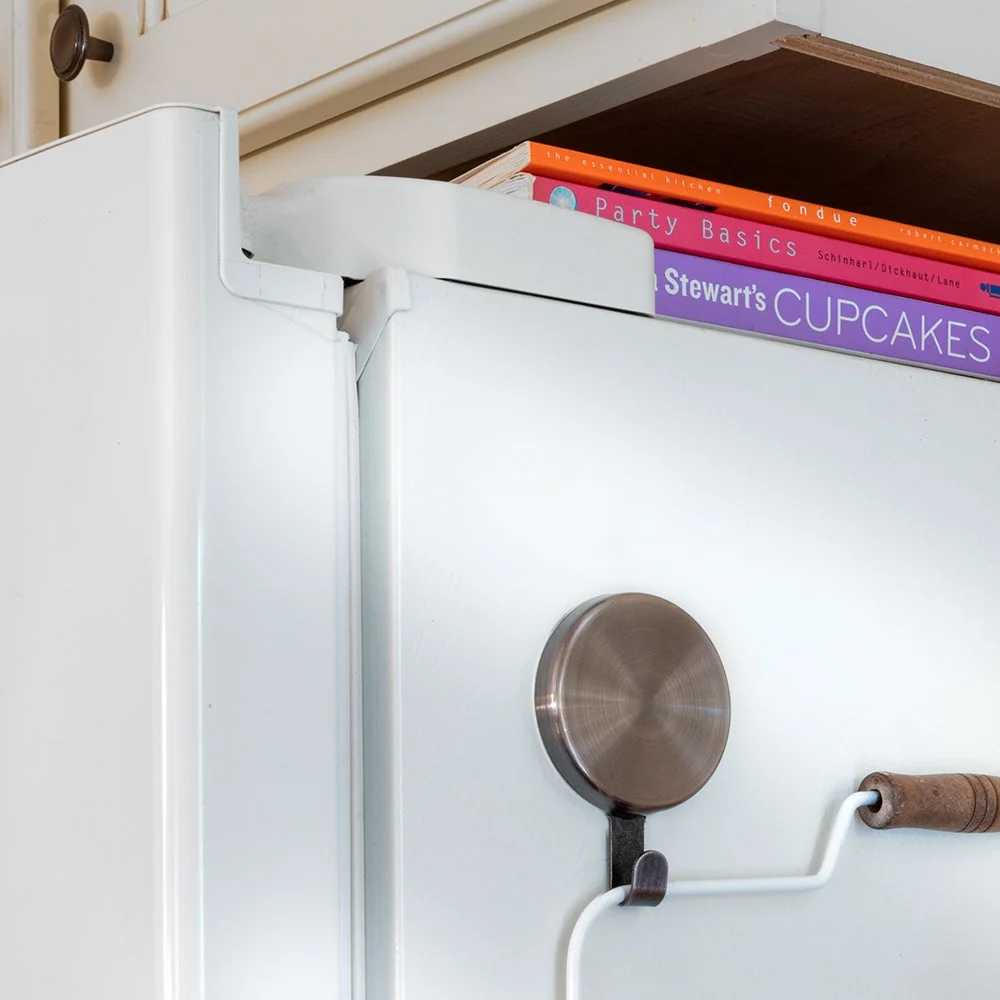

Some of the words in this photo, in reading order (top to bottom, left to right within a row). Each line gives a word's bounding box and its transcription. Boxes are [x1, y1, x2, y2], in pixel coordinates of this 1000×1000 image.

[547, 150, 571, 162] the
[582, 158, 655, 181] essential
[665, 176, 722, 195] kitchen
[595, 196, 679, 236] Party
[701, 218, 797, 257] Basics
[767, 195, 858, 227] fondue
[664, 266, 767, 312] Stewart's
[774, 287, 991, 363] CUPCAKES
